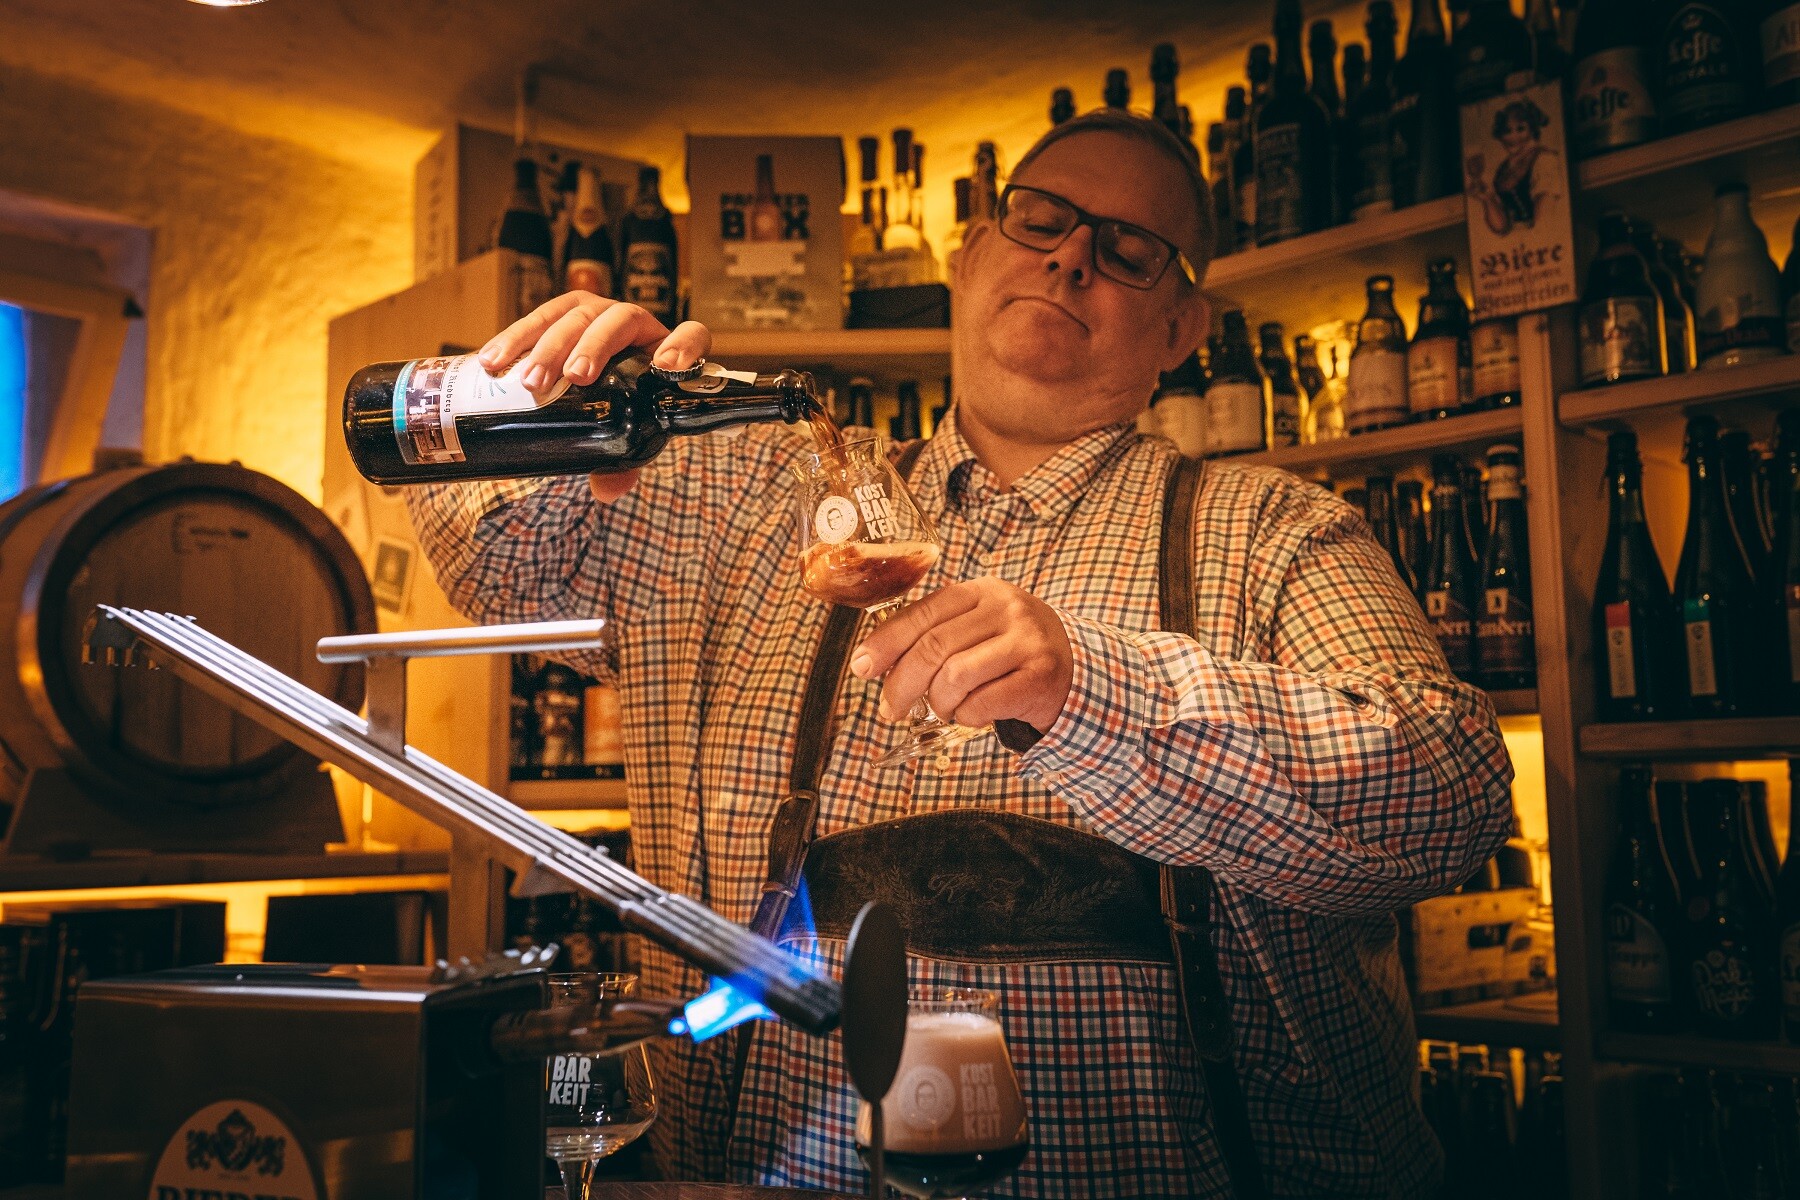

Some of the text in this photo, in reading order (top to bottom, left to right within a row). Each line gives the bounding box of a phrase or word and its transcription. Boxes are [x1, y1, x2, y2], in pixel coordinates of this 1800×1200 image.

[854, 482, 886, 503] KOST
[860, 497, 897, 522] BAR
[866, 516, 900, 540] KEIT
[552, 1055, 591, 1082] BAR
[959, 1062, 994, 1085] KOST
[549, 1081, 591, 1106] KEIT
[961, 1085, 1000, 1113] BAR
[963, 1114, 1001, 1140] KEIT
